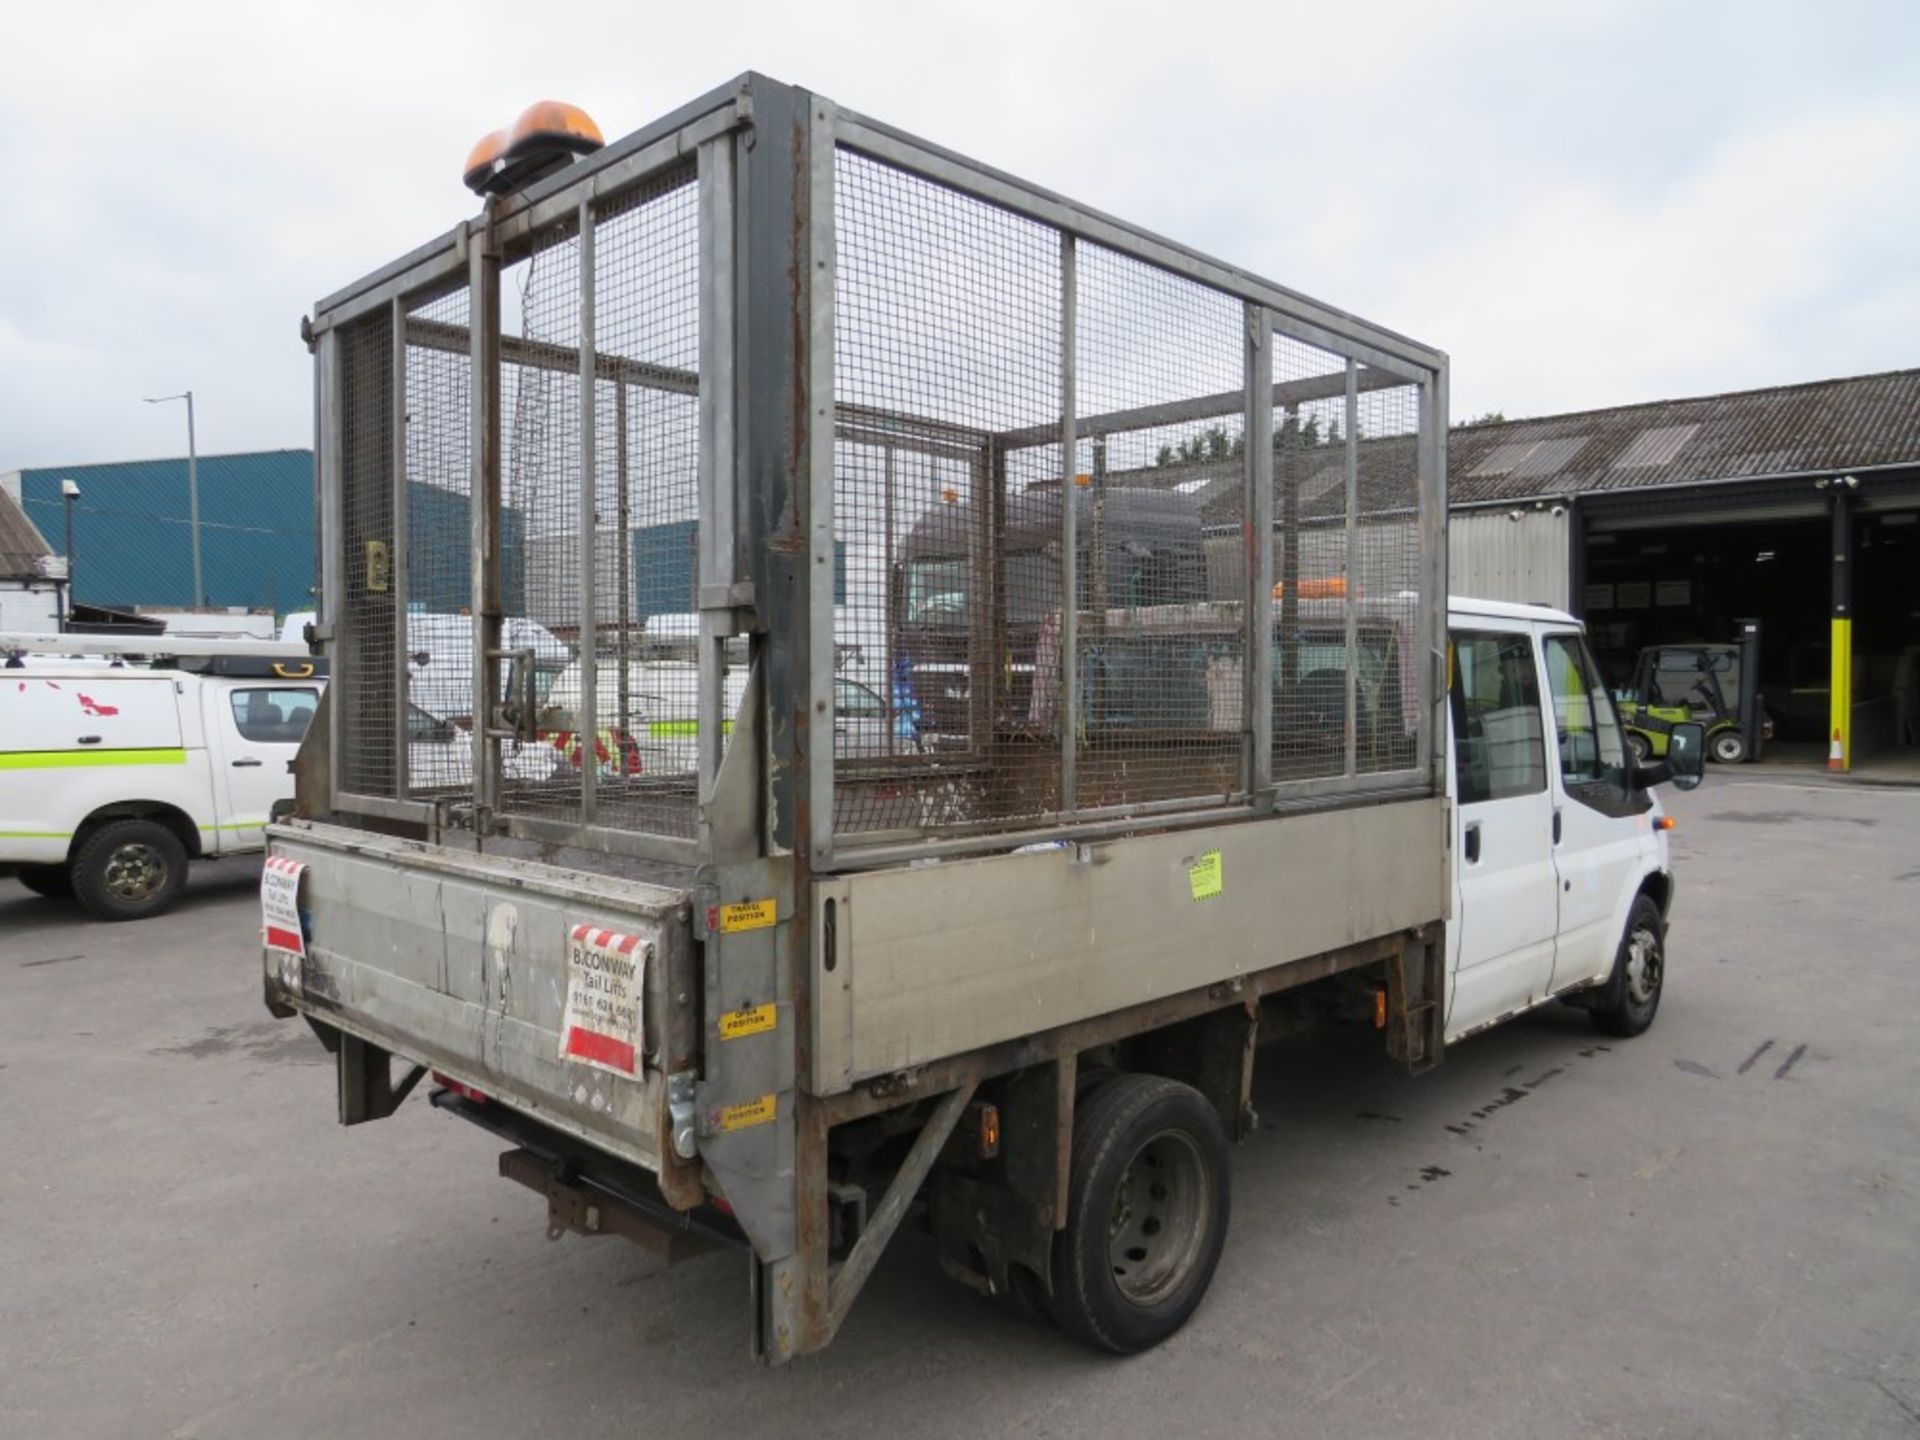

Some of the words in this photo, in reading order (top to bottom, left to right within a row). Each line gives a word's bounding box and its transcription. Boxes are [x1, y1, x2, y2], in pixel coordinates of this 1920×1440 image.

[727, 911, 765, 923] POSITION
[573, 949, 636, 980] B.CONWAY
[584, 972, 601, 990] Tail
[604, 978, 627, 999] Lifts
[727, 1015, 765, 1029] POSITION
[727, 1107, 765, 1121] POSITION
